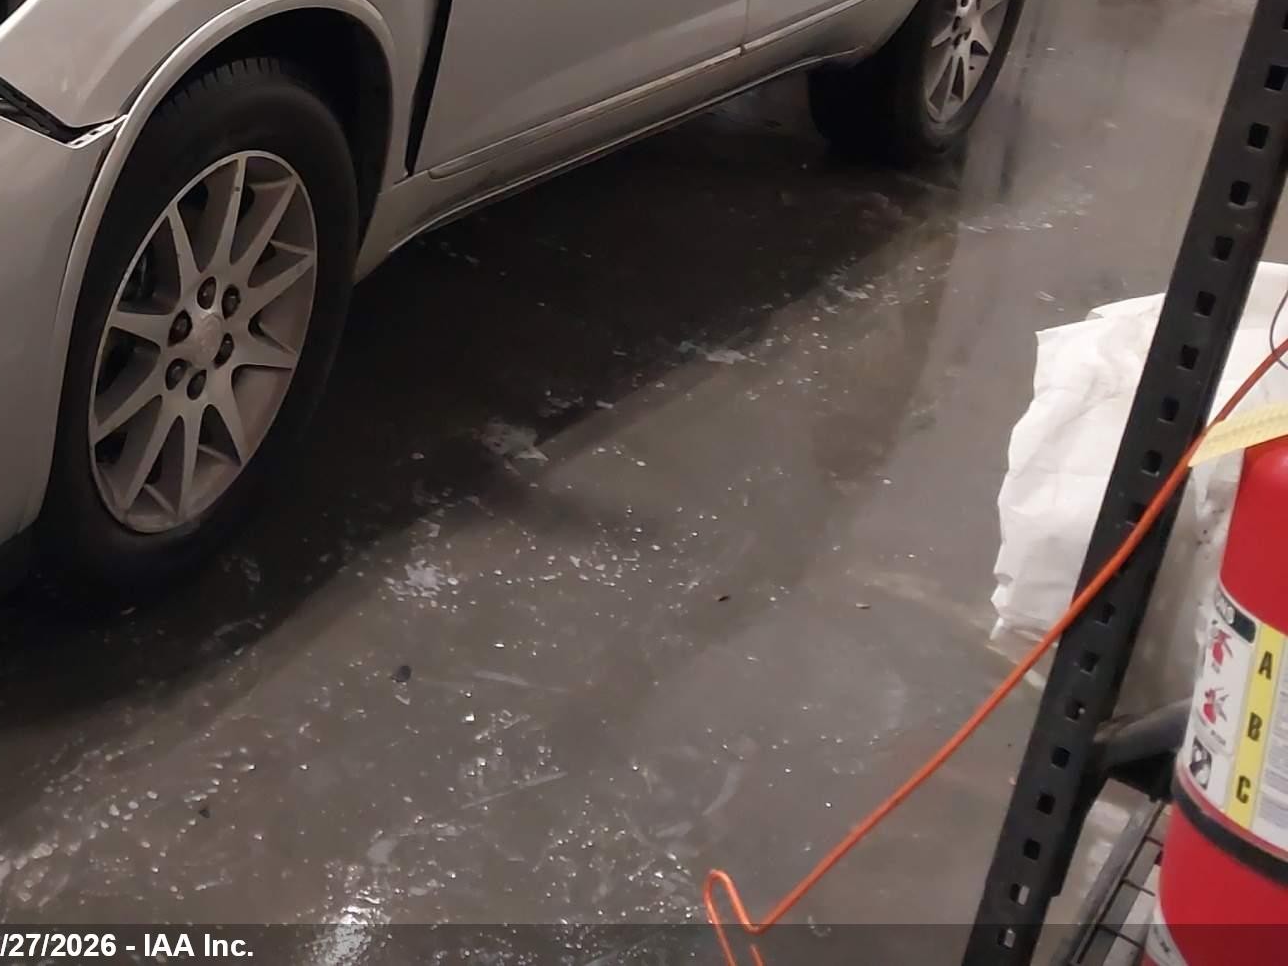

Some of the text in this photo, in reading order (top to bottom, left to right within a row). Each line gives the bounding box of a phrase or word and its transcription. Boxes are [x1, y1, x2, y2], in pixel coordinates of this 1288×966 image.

[1258, 650, 1273, 680] A
[1247, 711, 1263, 742] B
[1235, 775, 1252, 804] C
